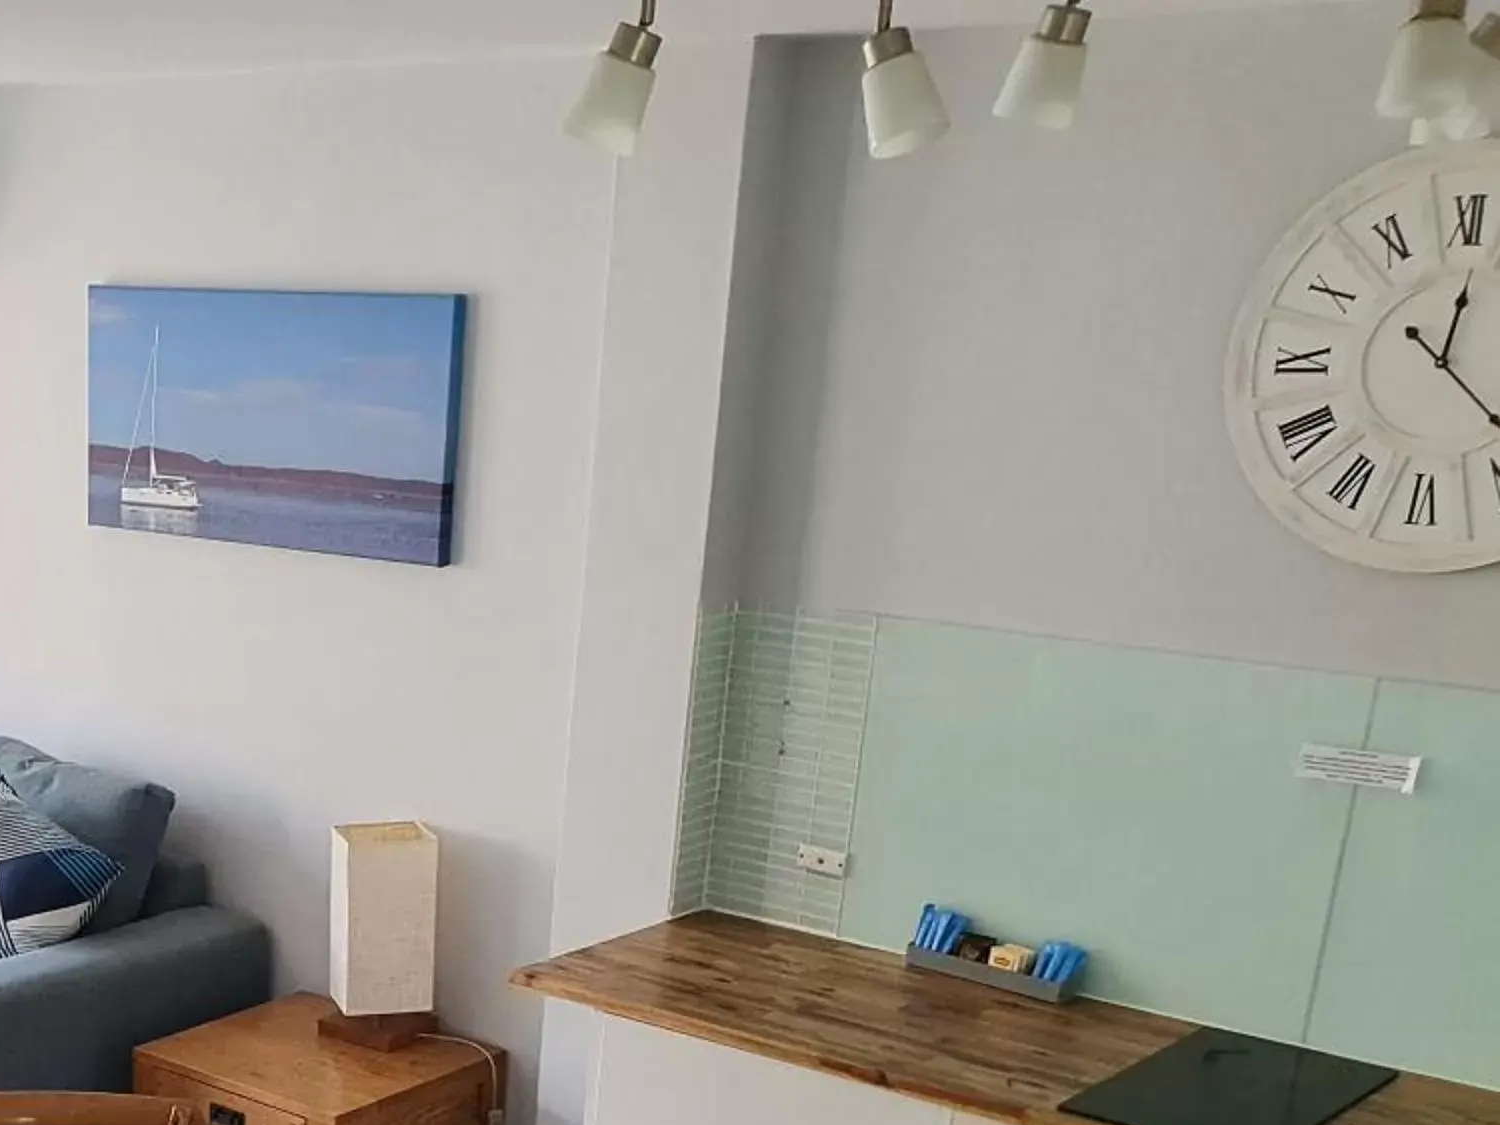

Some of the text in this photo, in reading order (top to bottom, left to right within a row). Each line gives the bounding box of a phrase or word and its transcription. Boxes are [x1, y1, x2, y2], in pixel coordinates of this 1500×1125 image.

[1372, 213, 1413, 269] XI
[1447, 193, 1488, 248] XII
[1308, 274, 1357, 315] X
[1274, 346, 1331, 376] IX
[1277, 404, 1338, 462] VIII
[1326, 452, 1376, 510] VII
[1404, 472, 1437, 526] VI
